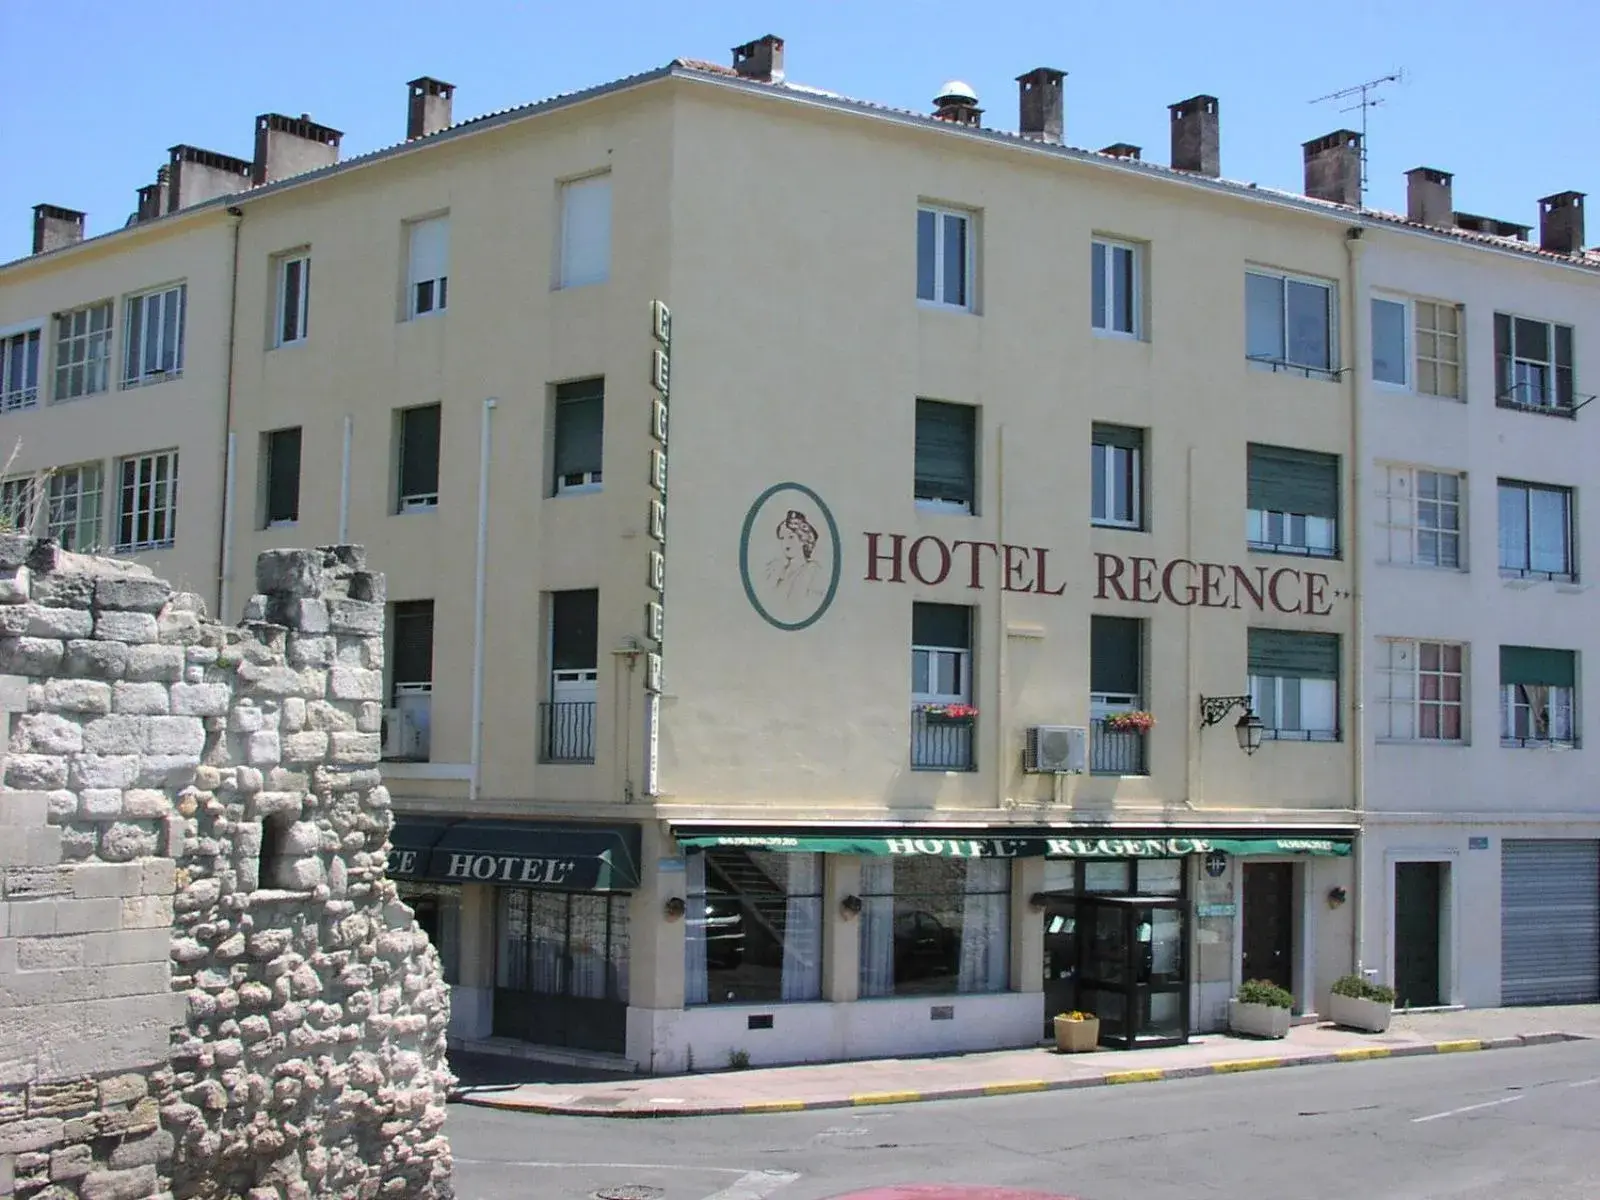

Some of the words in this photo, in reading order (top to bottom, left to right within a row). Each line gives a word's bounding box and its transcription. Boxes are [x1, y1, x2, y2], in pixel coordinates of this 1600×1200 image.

[651, 300, 671, 642] REGENCE
[863, 531, 1067, 596] HOTEL
[1093, 552, 1334, 616] REGENCE
[448, 853, 566, 885] HOTEL
[886, 838, 1017, 858] HOTEL
[1045, 837, 1215, 856] REGENCE
